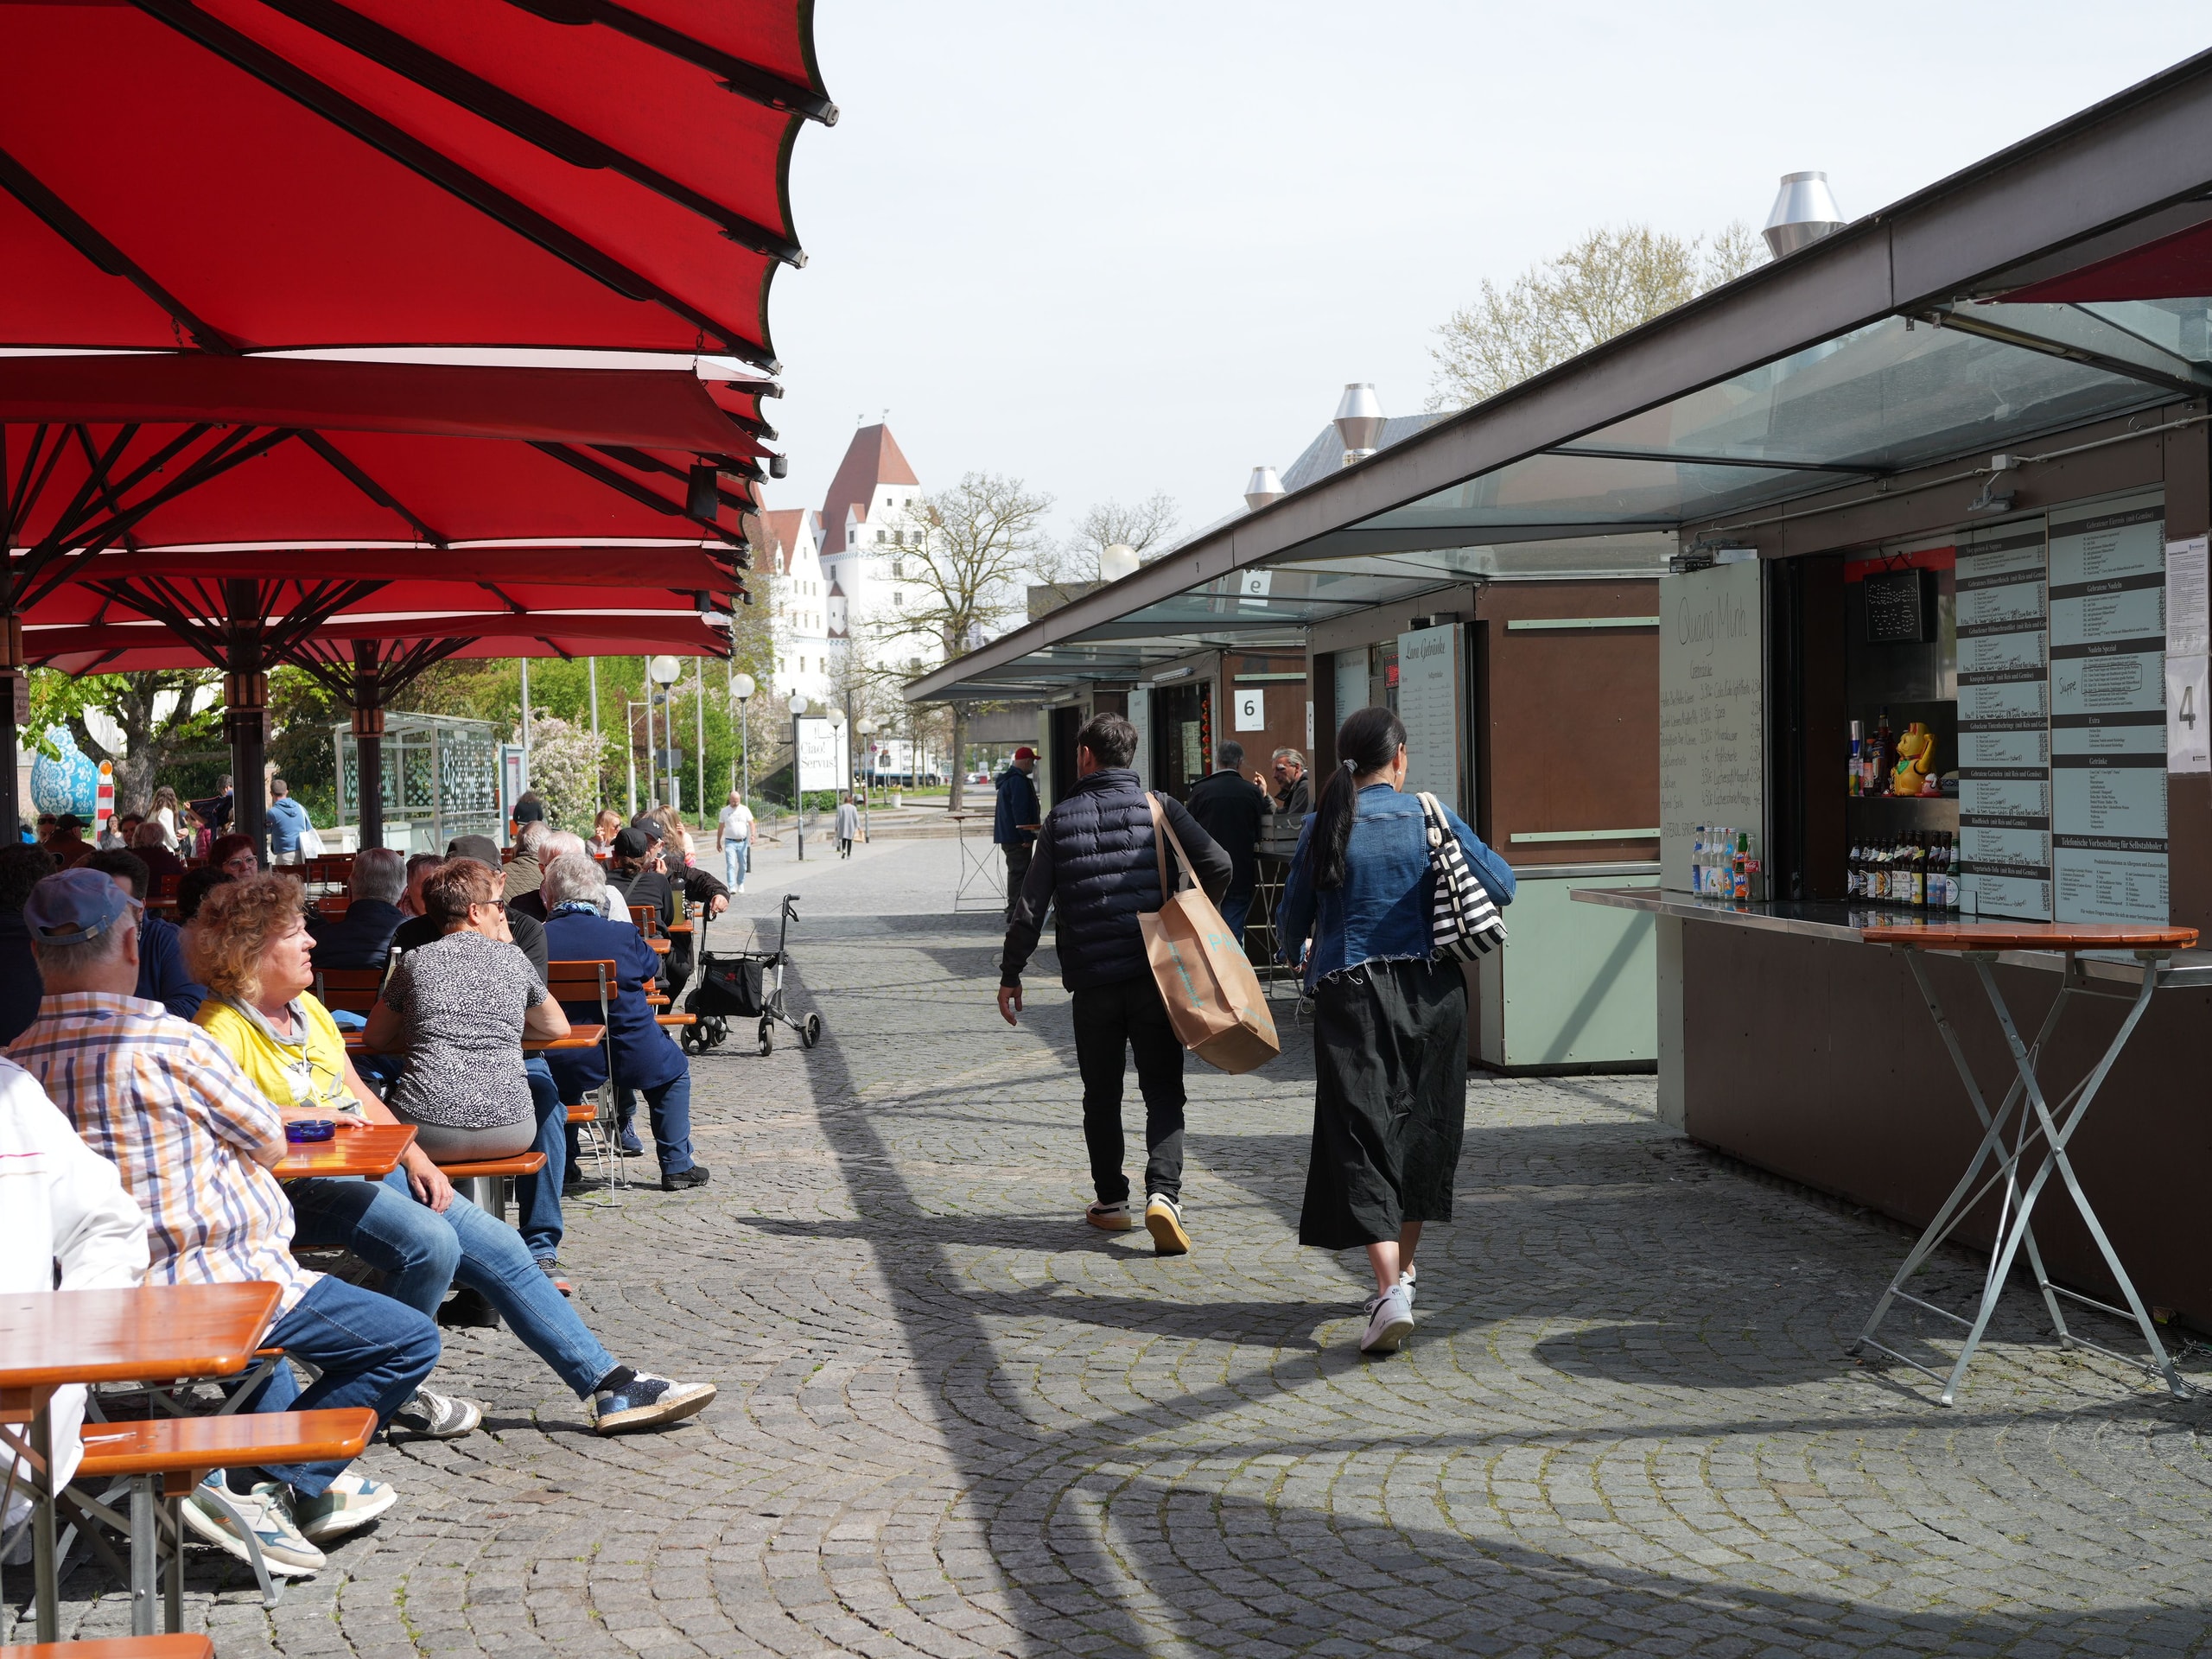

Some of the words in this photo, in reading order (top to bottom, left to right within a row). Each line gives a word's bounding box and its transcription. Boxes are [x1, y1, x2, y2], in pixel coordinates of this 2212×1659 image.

[2107, 581, 2122, 589] Nudeln
[1718, 592, 1748, 639] Minh
[1421, 635, 1446, 662] Getränke
[2102, 644, 2117, 654] Spezial
[2058, 677, 2076, 697] Suppe
[1244, 700, 1255, 716] 6
[2179, 686, 2196, 730] 4
[801, 741, 825, 754] Ciao!
[801, 755, 836, 769] Servus!
[2088, 757, 2107, 766] Getränke
[2061, 837, 2088, 848] Telefonische
[2088, 838, 2120, 850] Vorbestellung
[2128, 841, 2162, 851] Selbstabholer
